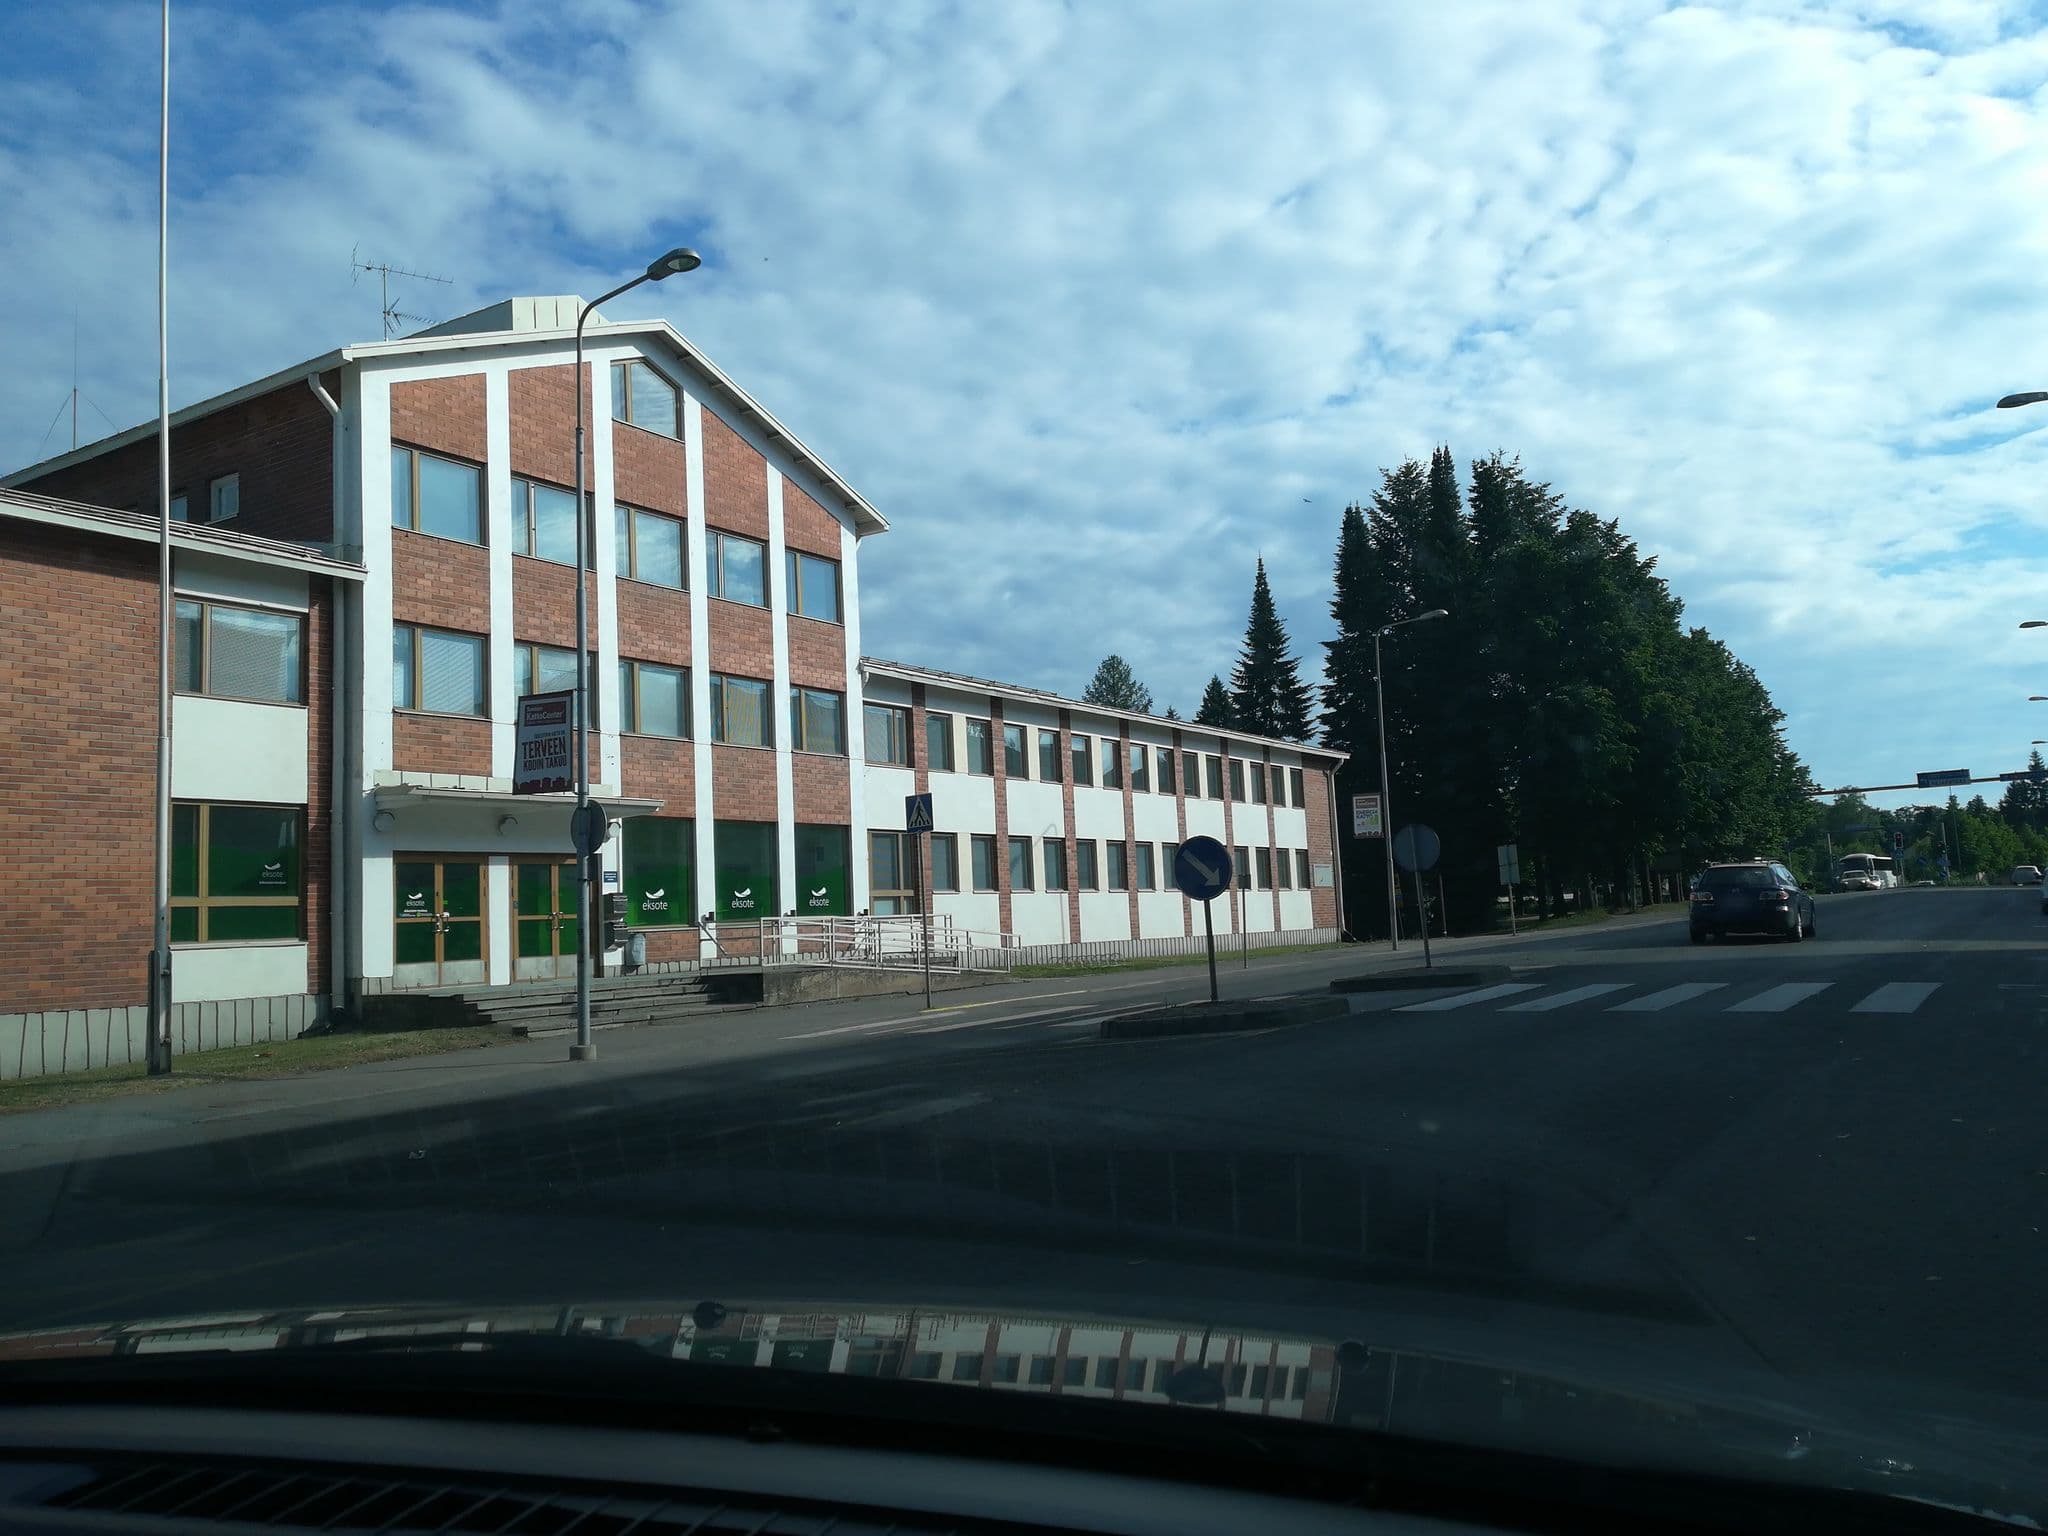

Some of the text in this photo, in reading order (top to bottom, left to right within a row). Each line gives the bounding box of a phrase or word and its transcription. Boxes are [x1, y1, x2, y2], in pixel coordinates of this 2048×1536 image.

[522, 736, 567, 760] TERVEEN
[545, 754, 568, 769] TAKUU
[262, 870, 285, 879] eksote
[406, 898, 425, 907] eksote
[642, 899, 669, 911] eksote
[731, 898, 755, 909] eksote
[808, 897, 830, 907] eksote
